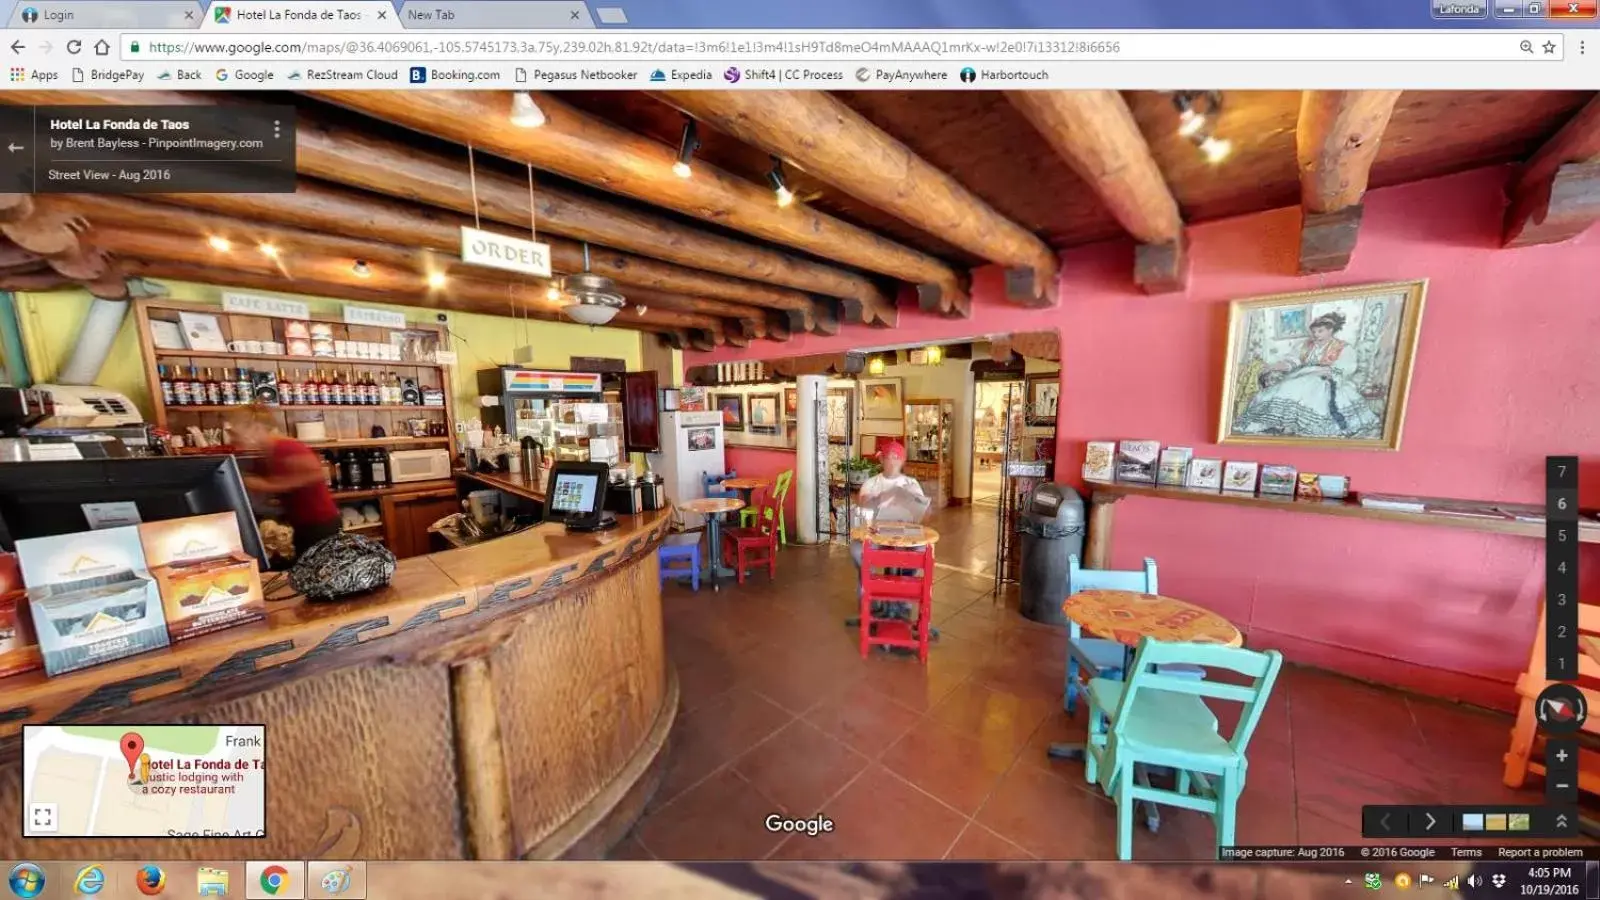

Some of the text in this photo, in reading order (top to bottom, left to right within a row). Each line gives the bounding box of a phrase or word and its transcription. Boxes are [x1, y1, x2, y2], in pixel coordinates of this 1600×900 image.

[44, 9, 74, 23] Login
[237, 9, 361, 20] Hotel La Fonda de Taos
[408, 9, 455, 20] New Tab
[31, 69, 58, 83] Apps
[91, 69, 145, 83] BridgePay
[177, 69, 202, 80] Back
[235, 69, 274, 83] Google
[307, 69, 398, 80] RezStream Cloud
[431, 69, 500, 83] Booking.com
[534, 69, 638, 83] Pegasus Netbooker
[671, 69, 713, 82] Expedia
[745, 69, 776, 80] Shift4
[784, 69, 800, 80] CC
[803, 69, 843, 80] Process
[876, 69, 948, 83] PayAnywhere
[981, 69, 1049, 80] Harbortouch
[472, 239, 544, 267] ORDER
[1528, 867, 1572, 878] 4:05 PM
[1520, 884, 1580, 896] 10/19/2016
